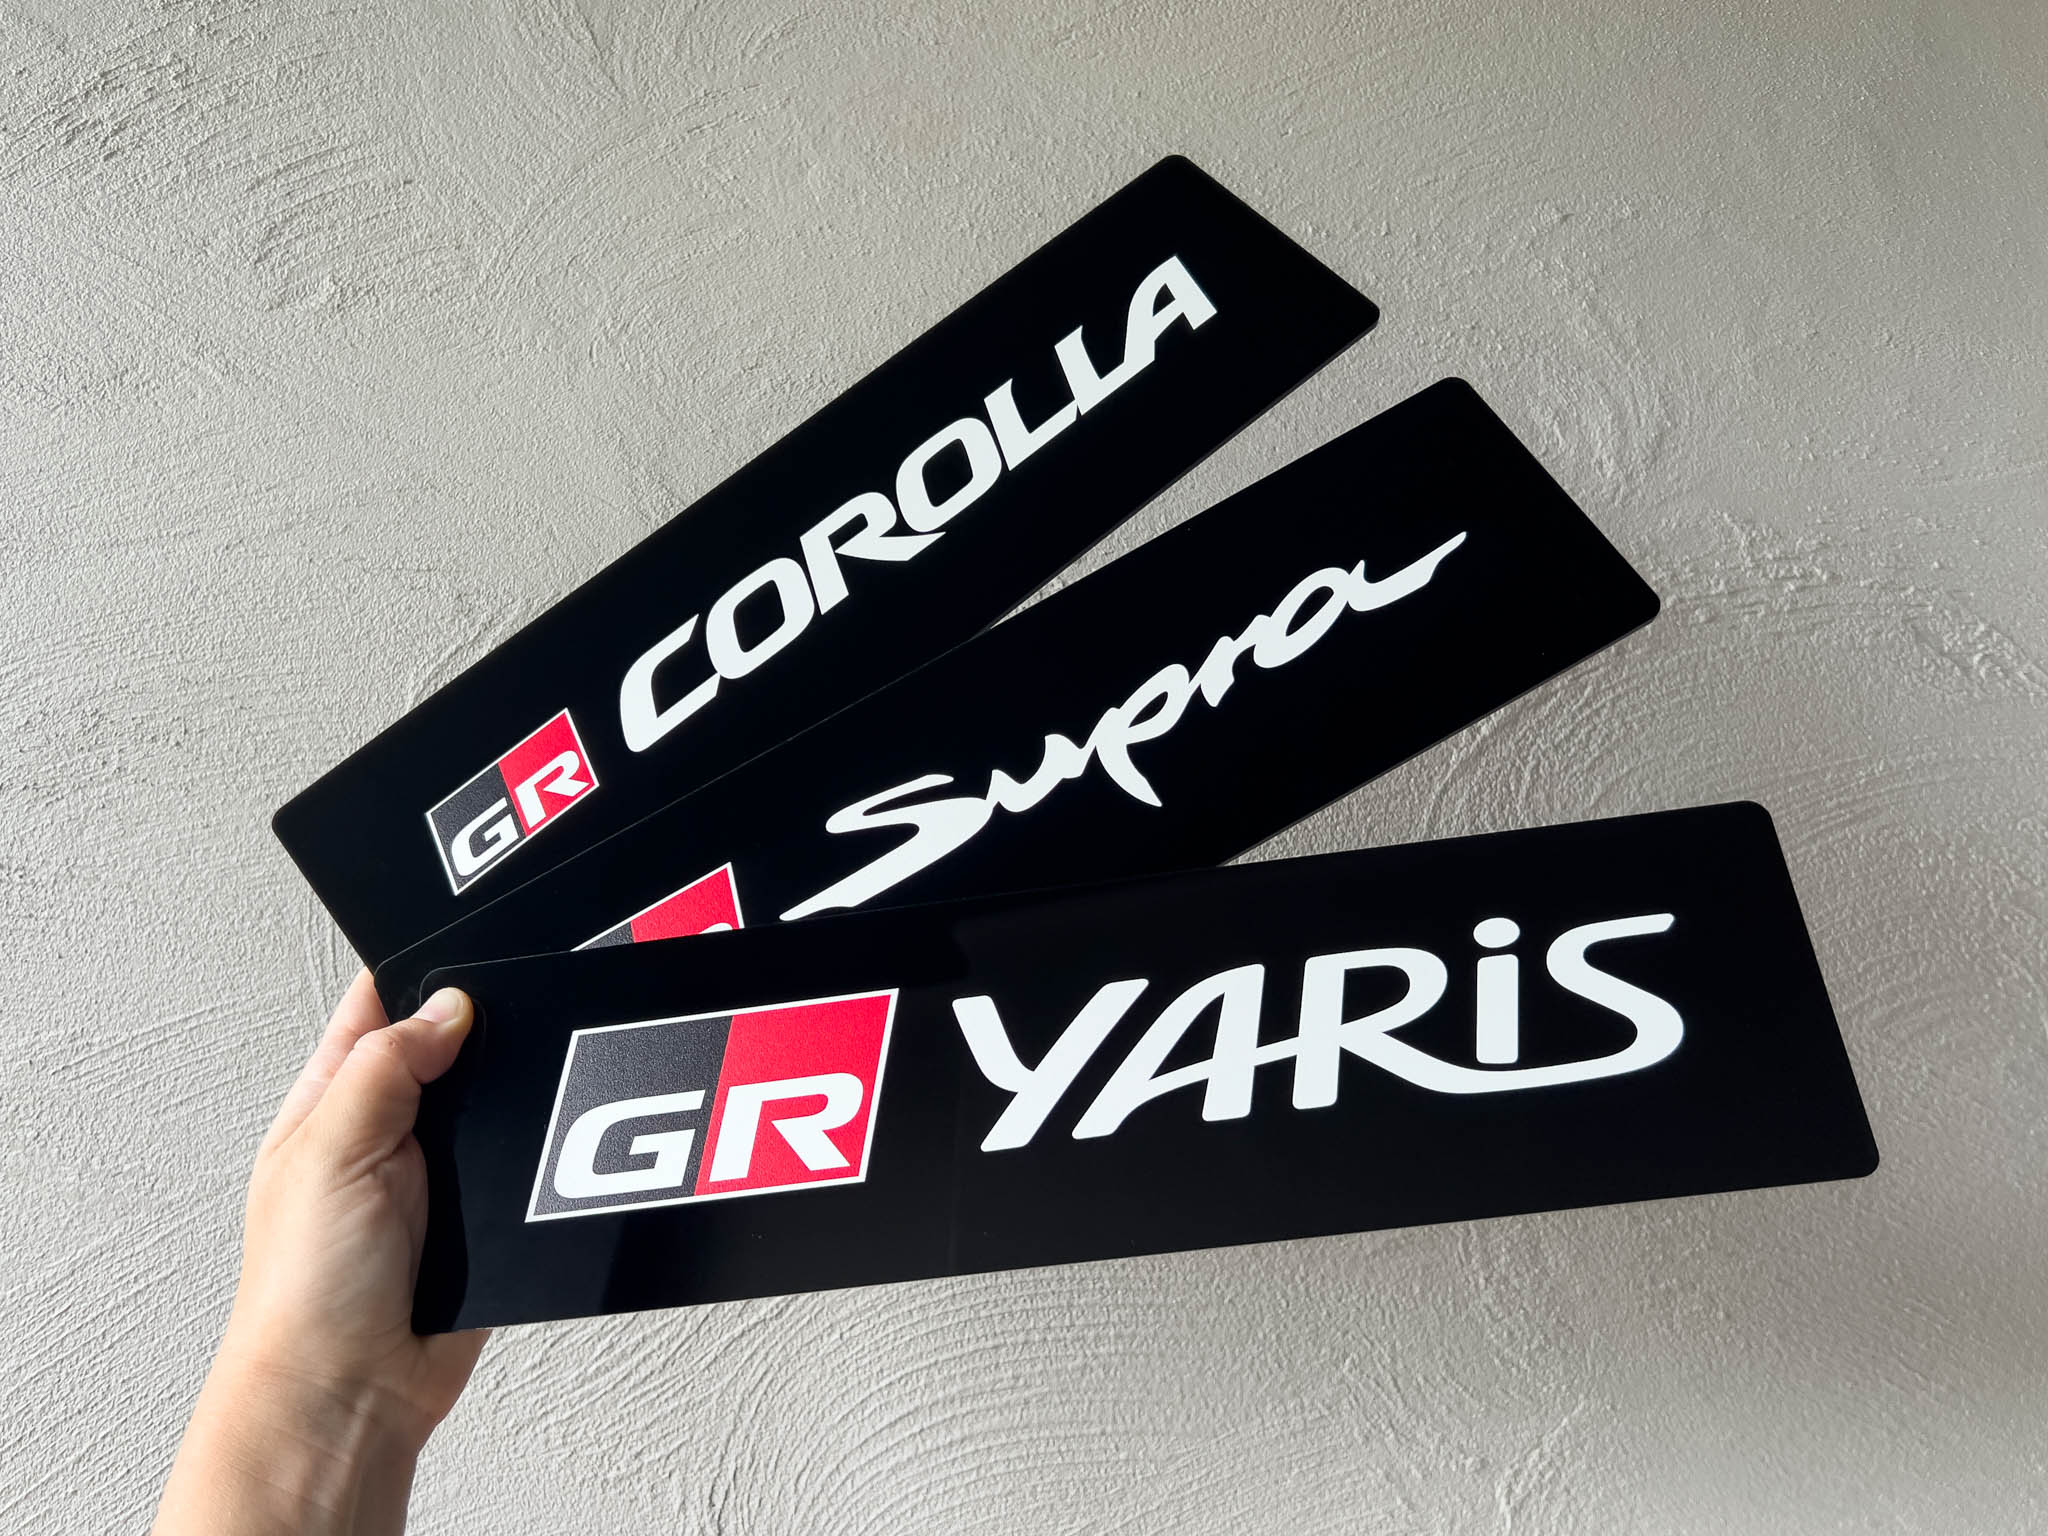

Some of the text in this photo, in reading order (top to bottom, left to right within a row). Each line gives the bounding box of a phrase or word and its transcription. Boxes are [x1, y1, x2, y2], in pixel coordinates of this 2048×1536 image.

[451, 255, 1217, 877] GR COROLLA
[779, 531, 1467, 921] Supra
[553, 1072, 865, 1199] GR
